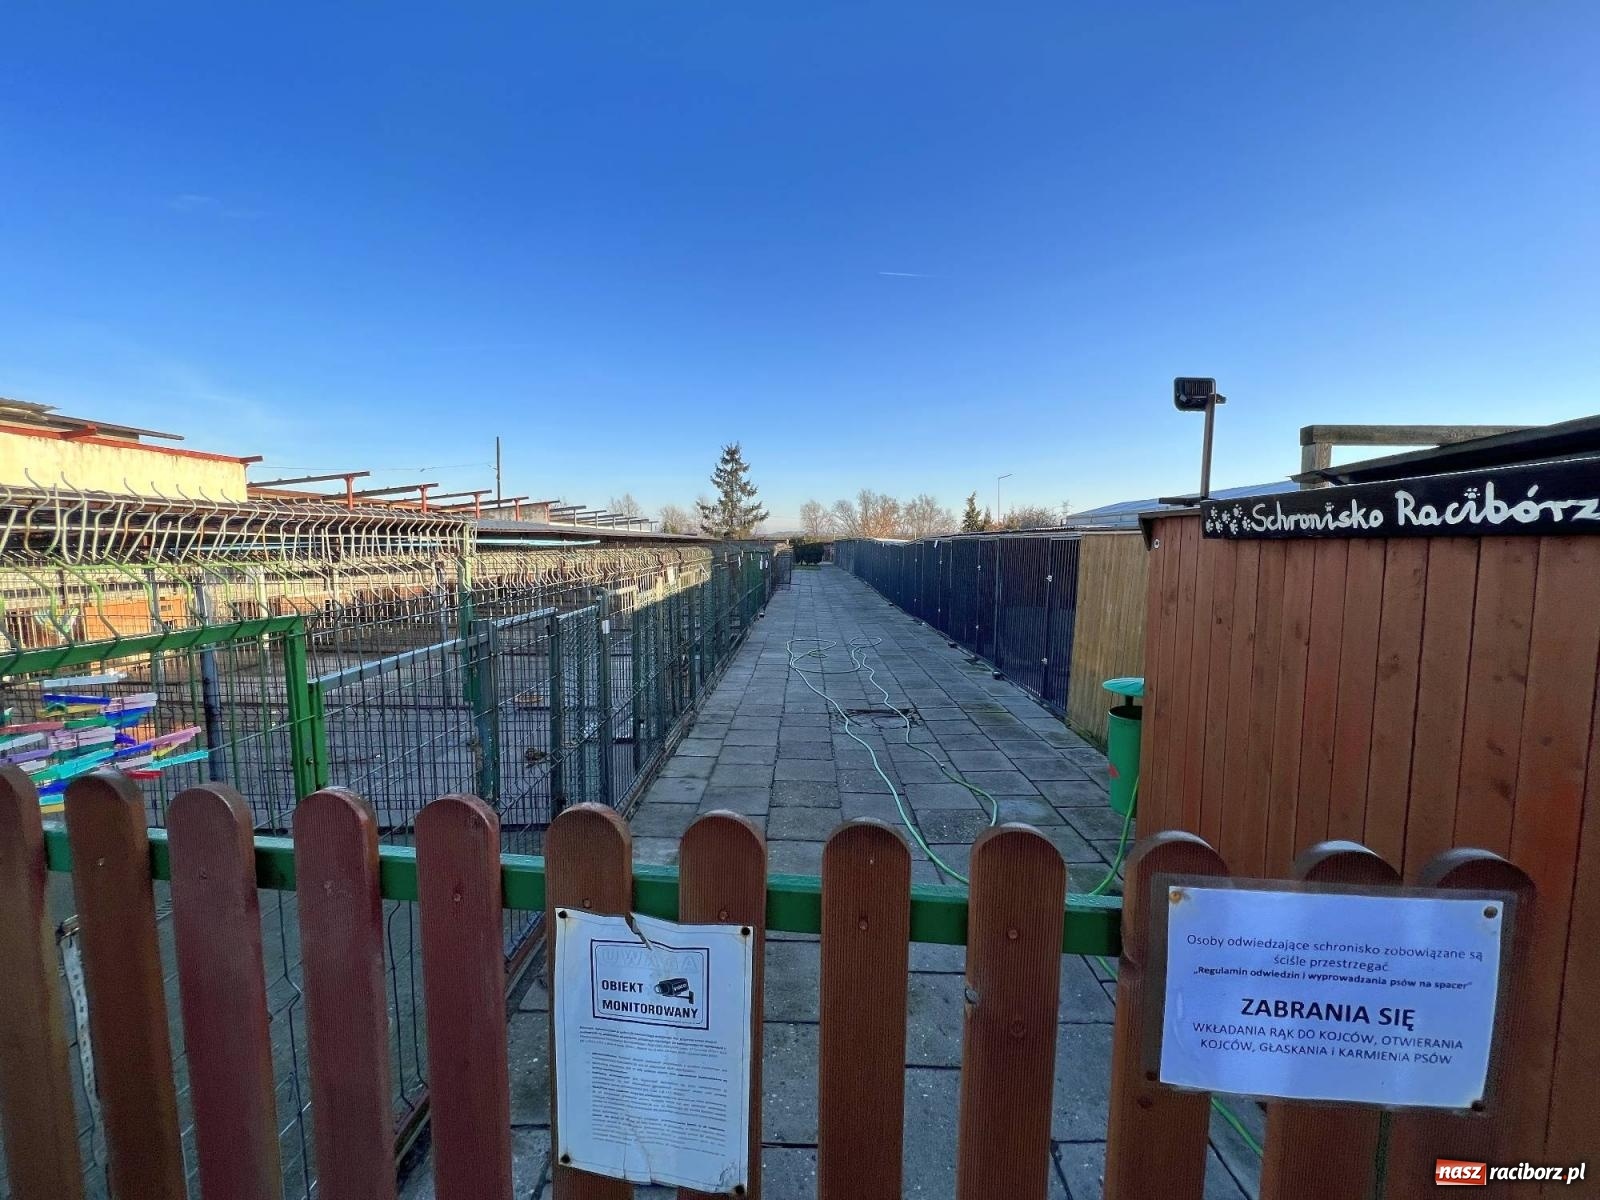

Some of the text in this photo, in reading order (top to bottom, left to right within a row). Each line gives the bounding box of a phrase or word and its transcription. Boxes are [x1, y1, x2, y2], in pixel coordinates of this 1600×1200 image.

[1251, 481, 1600, 531] Schronisko Racibórz
[1187, 934, 1483, 962] Osoby odwiedzające schronisko zobowiązane są
[1273, 954, 1389, 973] ściśle przestrzegać
[601, 980, 644, 993] OBIEKT
[1250, 969, 1300, 980] odwiedzin
[1308, 973, 1387, 986] wyprowadzania
[1389, 979, 1417, 988] psów
[602, 999, 699, 1019] MONITOROWANY
[1241, 998, 1416, 1032] ZABRANIA SIĘ
[1193, 1022, 1463, 1049] WKŁADANIA RĄK DO KOJCÓW, OTWIERANIA
[1200, 1039, 1256, 1053] KOJCÓW,
[1259, 1042, 1328, 1055] GŁASKANIA
[1339, 1047, 1410, 1062] KARMIENIA
[1414, 1052, 1453, 1065] PSÓW
